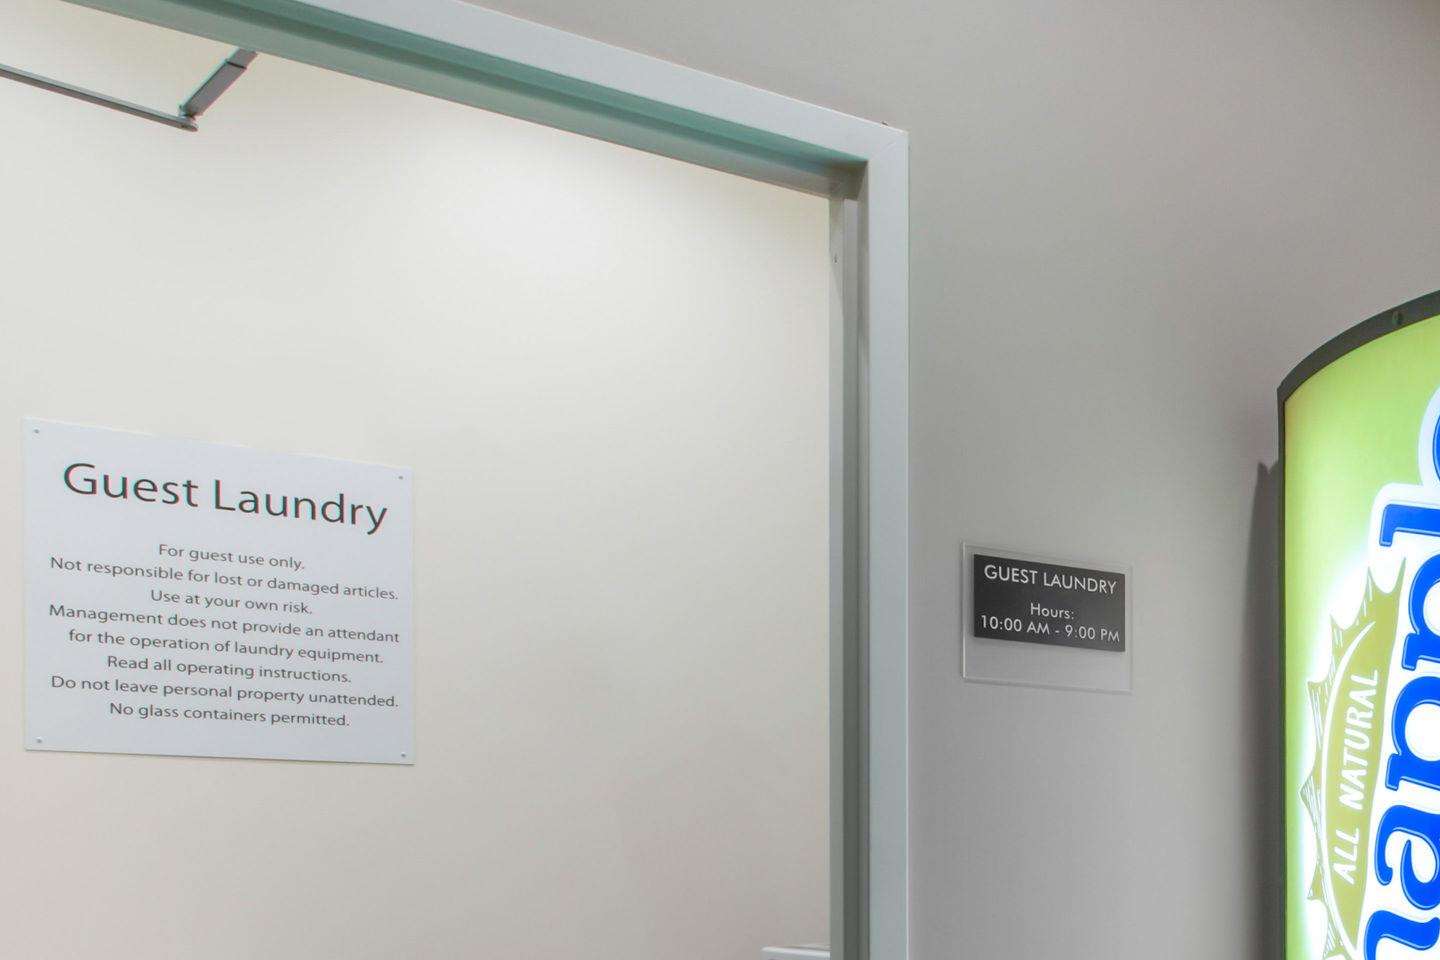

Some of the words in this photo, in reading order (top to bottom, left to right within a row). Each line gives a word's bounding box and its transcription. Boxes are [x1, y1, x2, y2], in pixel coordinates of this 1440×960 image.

[63, 462, 199, 507] Guest
[215, 480, 388, 535] Laundry
[159, 544, 184, 557] For
[189, 549, 233, 562] guest
[238, 554, 264, 565] use
[269, 557, 305, 571] only.
[50, 557, 82, 571] Not
[87, 562, 183, 581] responsible
[187, 569, 210, 582] for
[215, 572, 242, 586] lost
[247, 577, 263, 587] or
[267, 578, 339, 595] damaged
[343, 587, 398, 600] articles.
[984, 564, 1038, 584] GUEST
[1043, 572, 1117, 594] LAUNDRY
[151, 589, 180, 603] Use
[185, 595, 200, 605] at
[205, 597, 240, 609] your
[245, 600, 278, 611] own
[283, 602, 312, 615] risk.
[1030, 602, 1074, 620] Hours:
[49, 604, 164, 625] Management
[168, 614, 206, 628] does
[211, 619, 237, 631] not
[243, 622, 301, 636] provide
[305, 626, 324, 637] an
[328, 628, 399, 643] attendant
[981, 615, 1021, 632] 10:00
[1027, 621, 1050, 634] AM
[1065, 625, 1095, 639] 9:00
[1101, 628, 1119, 642] PM
[69, 629, 92, 642] for
[98, 632, 125, 645] the
[130, 635, 209, 651] operation
[214, 640, 231, 652] of
[235, 641, 294, 660] laundry
[298, 648, 384, 664] equipment.
[107, 655, 148, 670] Read
[153, 659, 171, 671] all
[176, 662, 254, 679] operating
[259, 666, 351, 683] instructions.
[51, 675, 76, 688] Do
[81, 679, 110, 691] not
[115, 679, 158, 693] leave
[163, 685, 232, 698] personal
[237, 689, 304, 704] property
[309, 693, 398, 707] unattended.
[110, 702, 134, 715] No
[138, 704, 179, 718] glass
[184, 708, 266, 722] containers
[271, 713, 350, 726] permitted.
[1338, 670, 1378, 810] NATURAL
[1333, 828, 1359, 885] ALL
